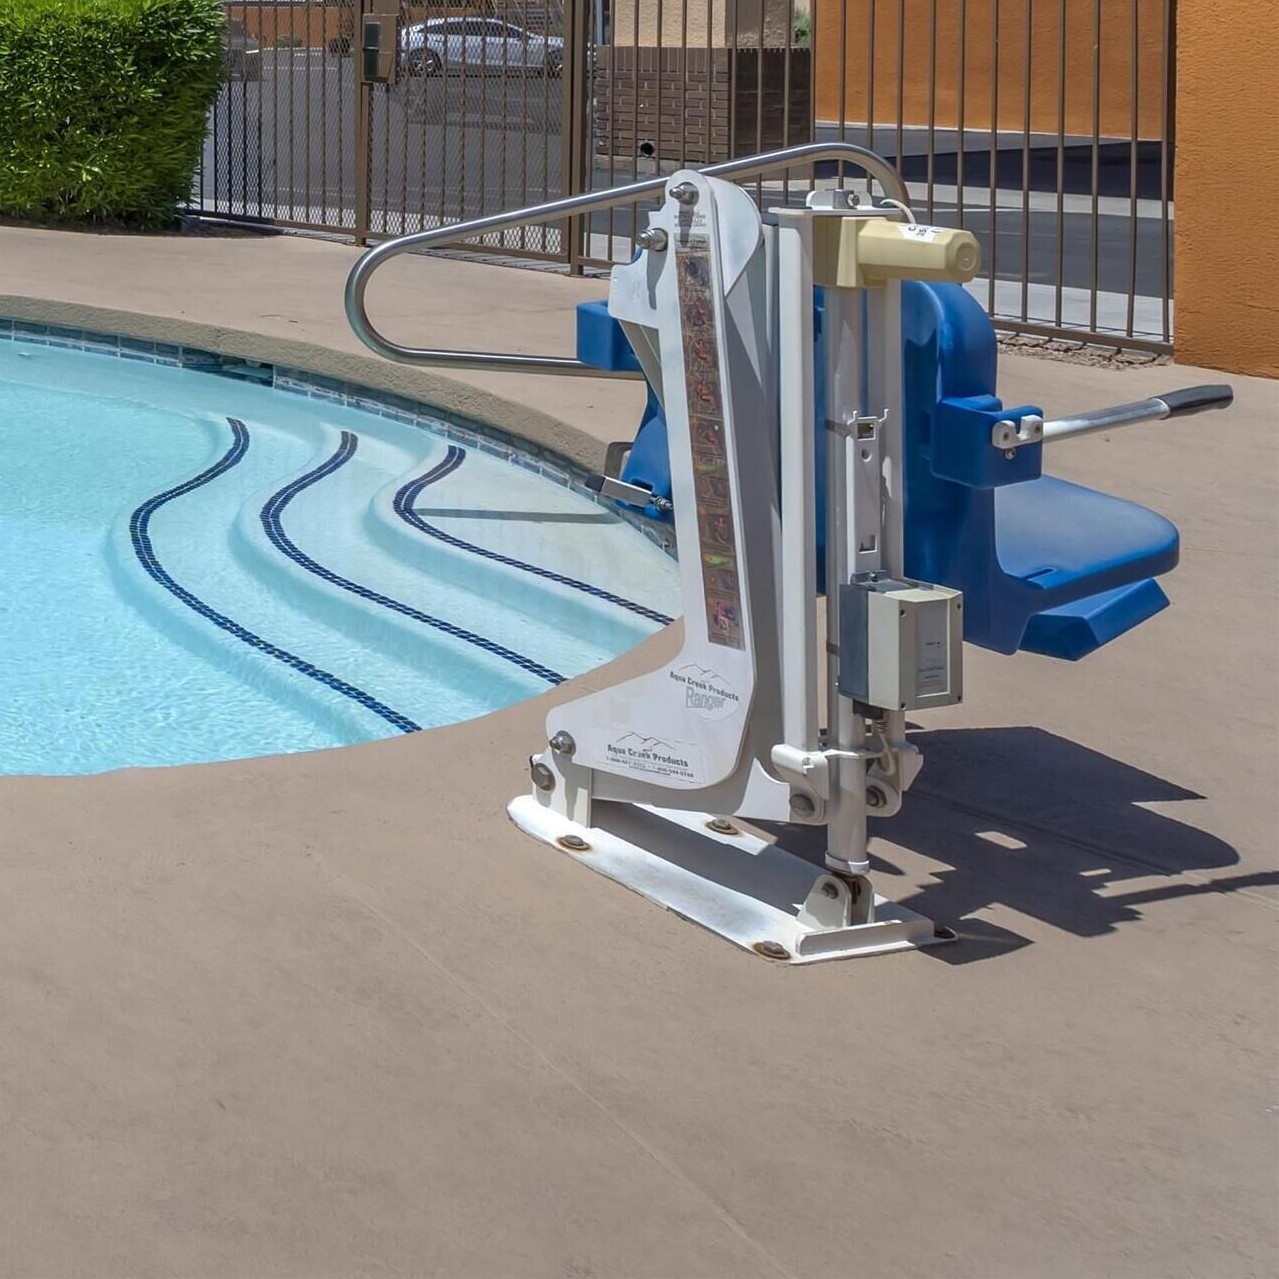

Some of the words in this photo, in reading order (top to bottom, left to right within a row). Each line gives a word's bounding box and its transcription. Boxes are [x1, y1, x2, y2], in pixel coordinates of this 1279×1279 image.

[670, 671, 686, 683] Aqua
[687, 676, 707, 690] Creek
[708, 684, 739, 702] Products
[686, 686, 726, 711] Ranger
[607, 744, 626, 756] Aqua
[652, 752, 689, 768] Products
